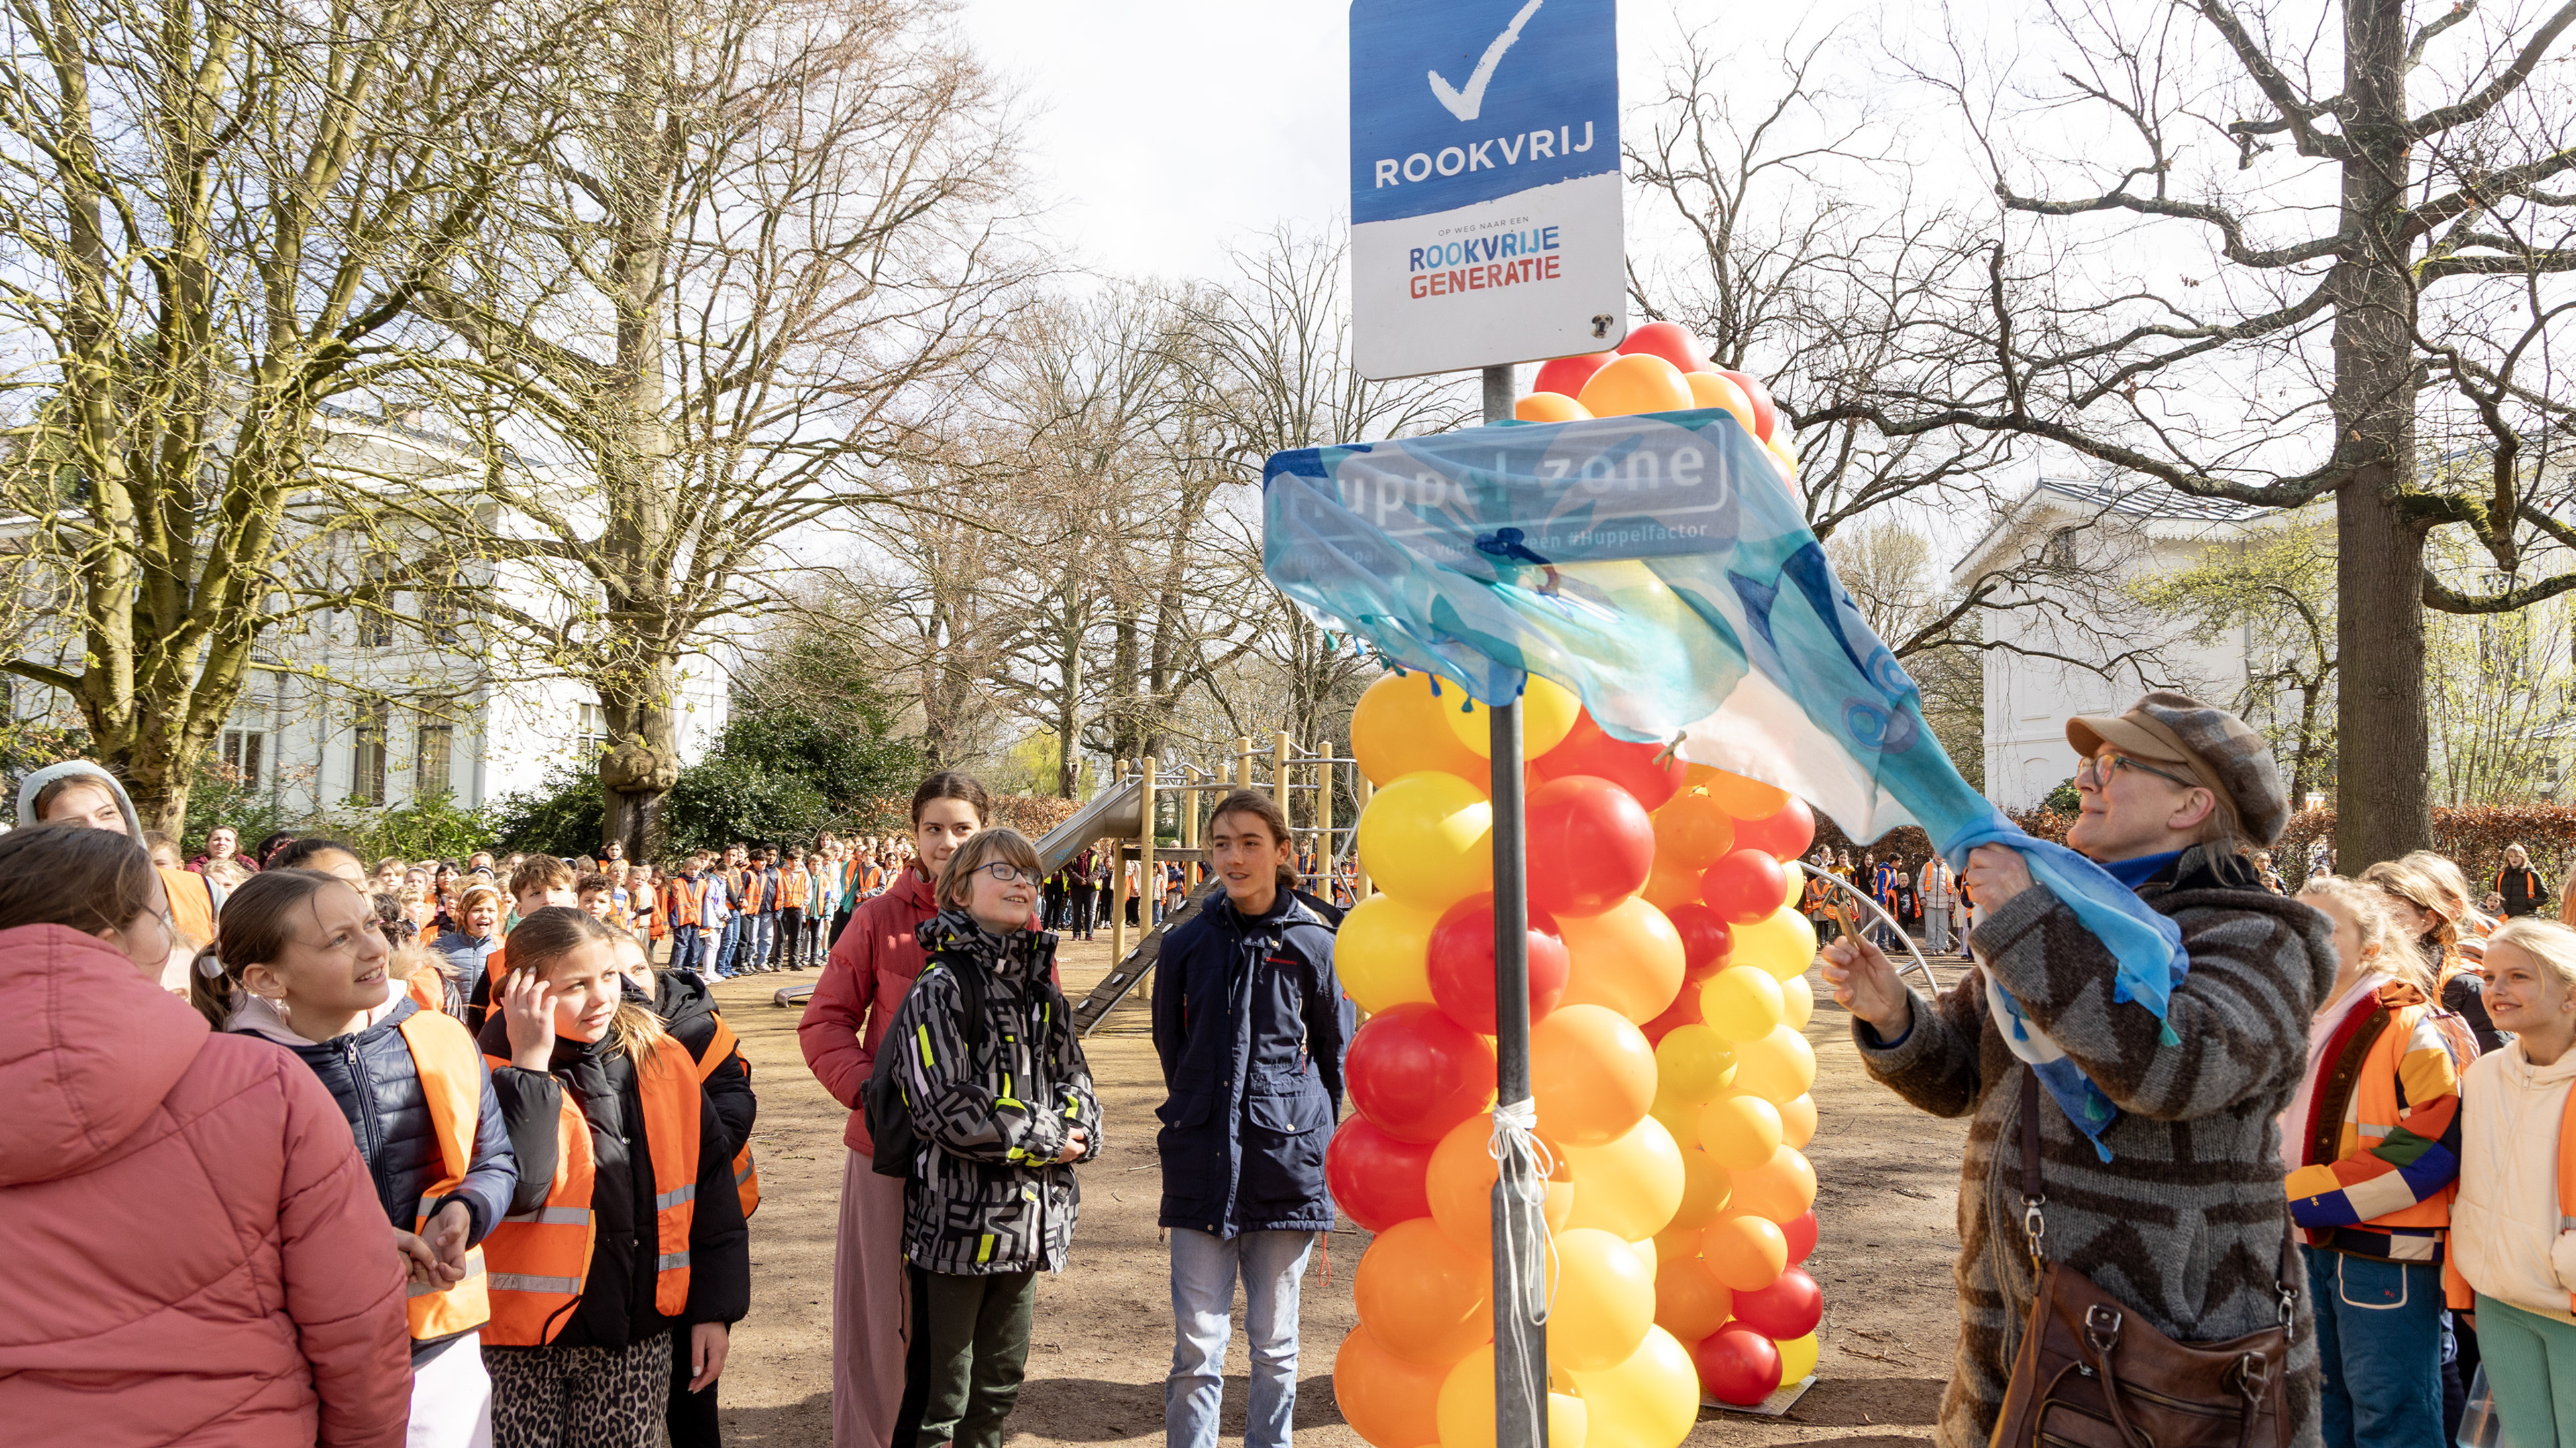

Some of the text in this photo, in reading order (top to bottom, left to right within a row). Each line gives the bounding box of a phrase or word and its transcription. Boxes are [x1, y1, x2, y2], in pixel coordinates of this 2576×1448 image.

[1375, 120, 1594, 188] ROOKVRIJ
[1409, 225, 1560, 272] ROOKVRIJE
[1438, 216, 1529, 237] OP WEG NAAR EEN
[1409, 255, 1561, 299] GENERATIE
[1542, 445, 1705, 498] zone
[1568, 522, 1709, 549] #Huppelfactor
